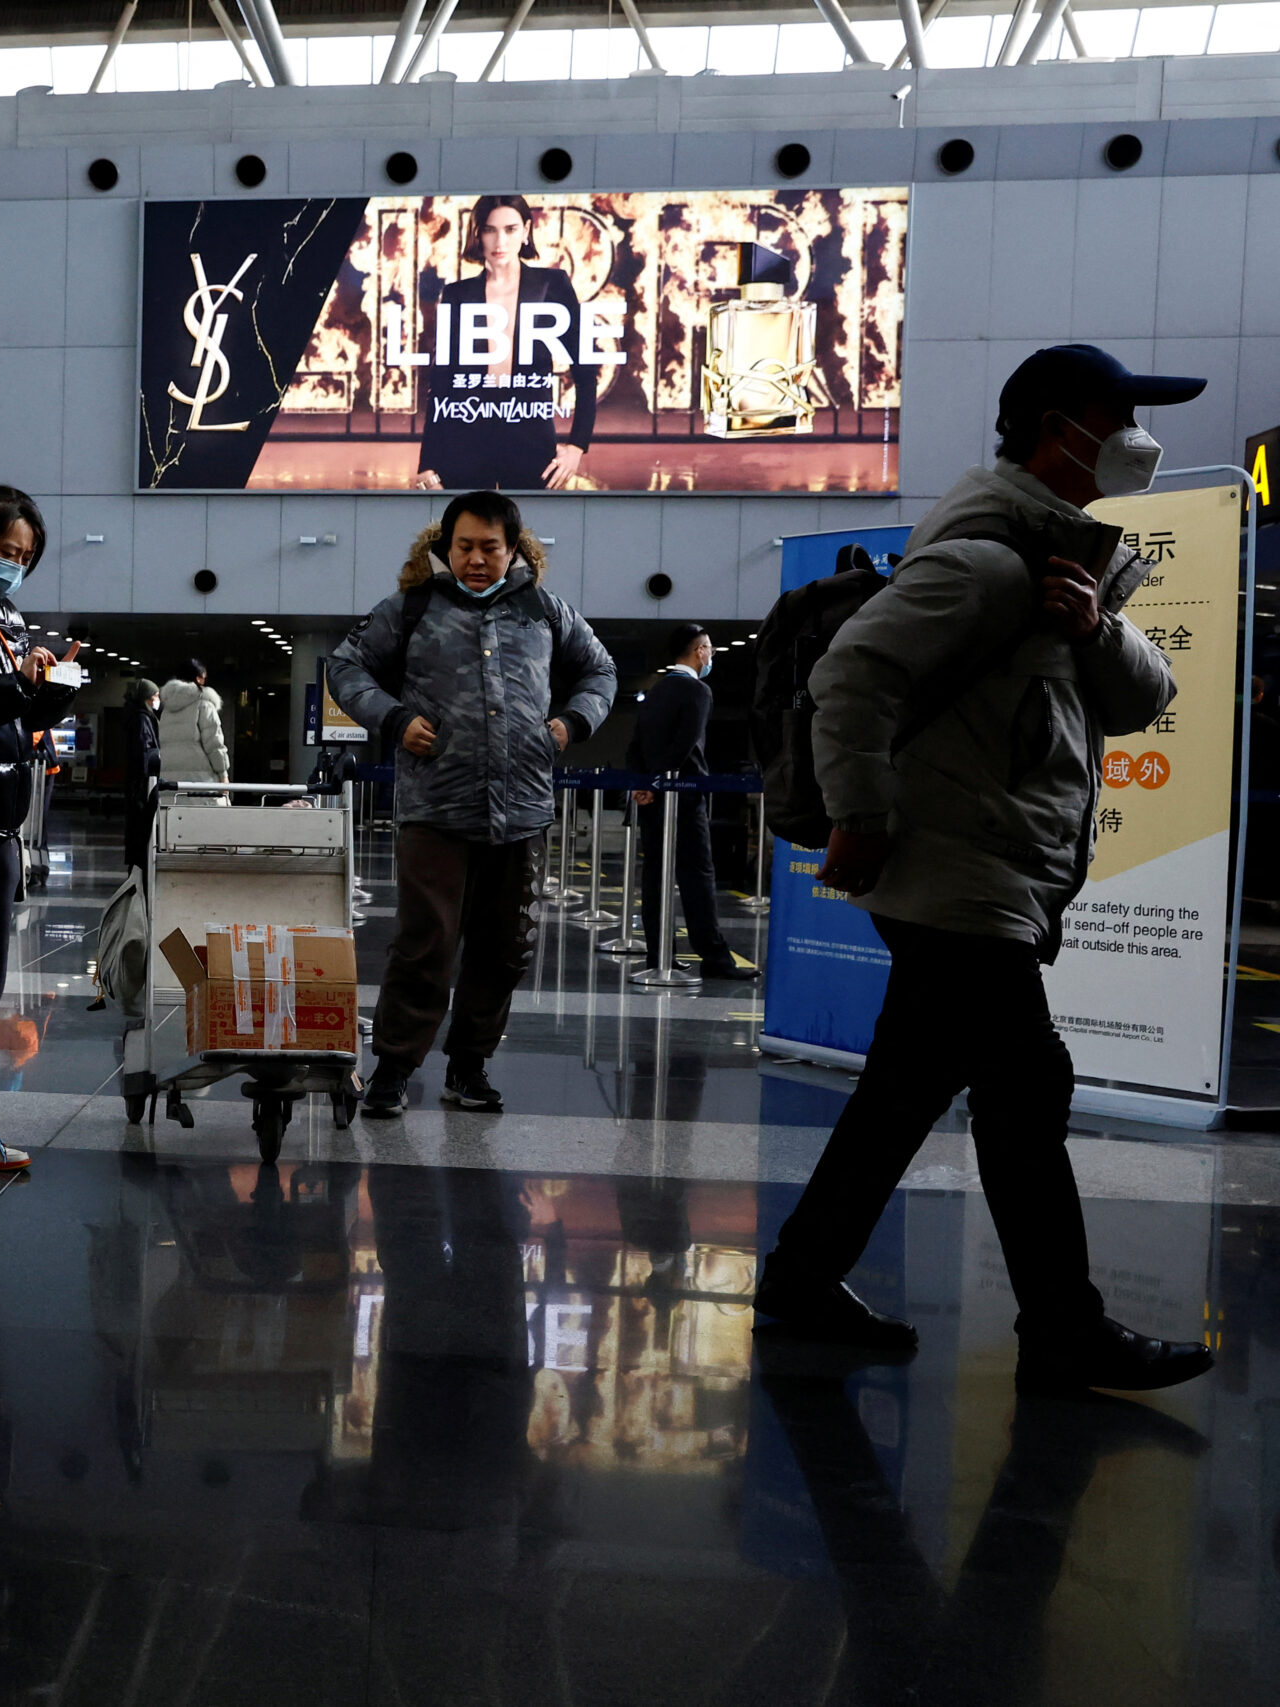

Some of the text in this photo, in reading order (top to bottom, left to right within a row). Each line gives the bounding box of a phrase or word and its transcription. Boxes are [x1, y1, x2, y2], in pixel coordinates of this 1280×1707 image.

[385, 302, 628, 366] LIBRE
[451, 372, 558, 389] 圣罗兰自由之水
[1245, 443, 1271, 511] A
[1145, 625, 1193, 651] 安全
[1105, 758, 1165, 783] 域外
[1097, 808, 1123, 833] 待
[1067, 901, 1199, 921] our safety during the
[1133, 925, 1178, 940] people
[1181, 930, 1203, 941] are
[1081, 940, 1125, 953] outside
[1127, 942, 1149, 955] this
[1151, 946, 1182, 959] area.
